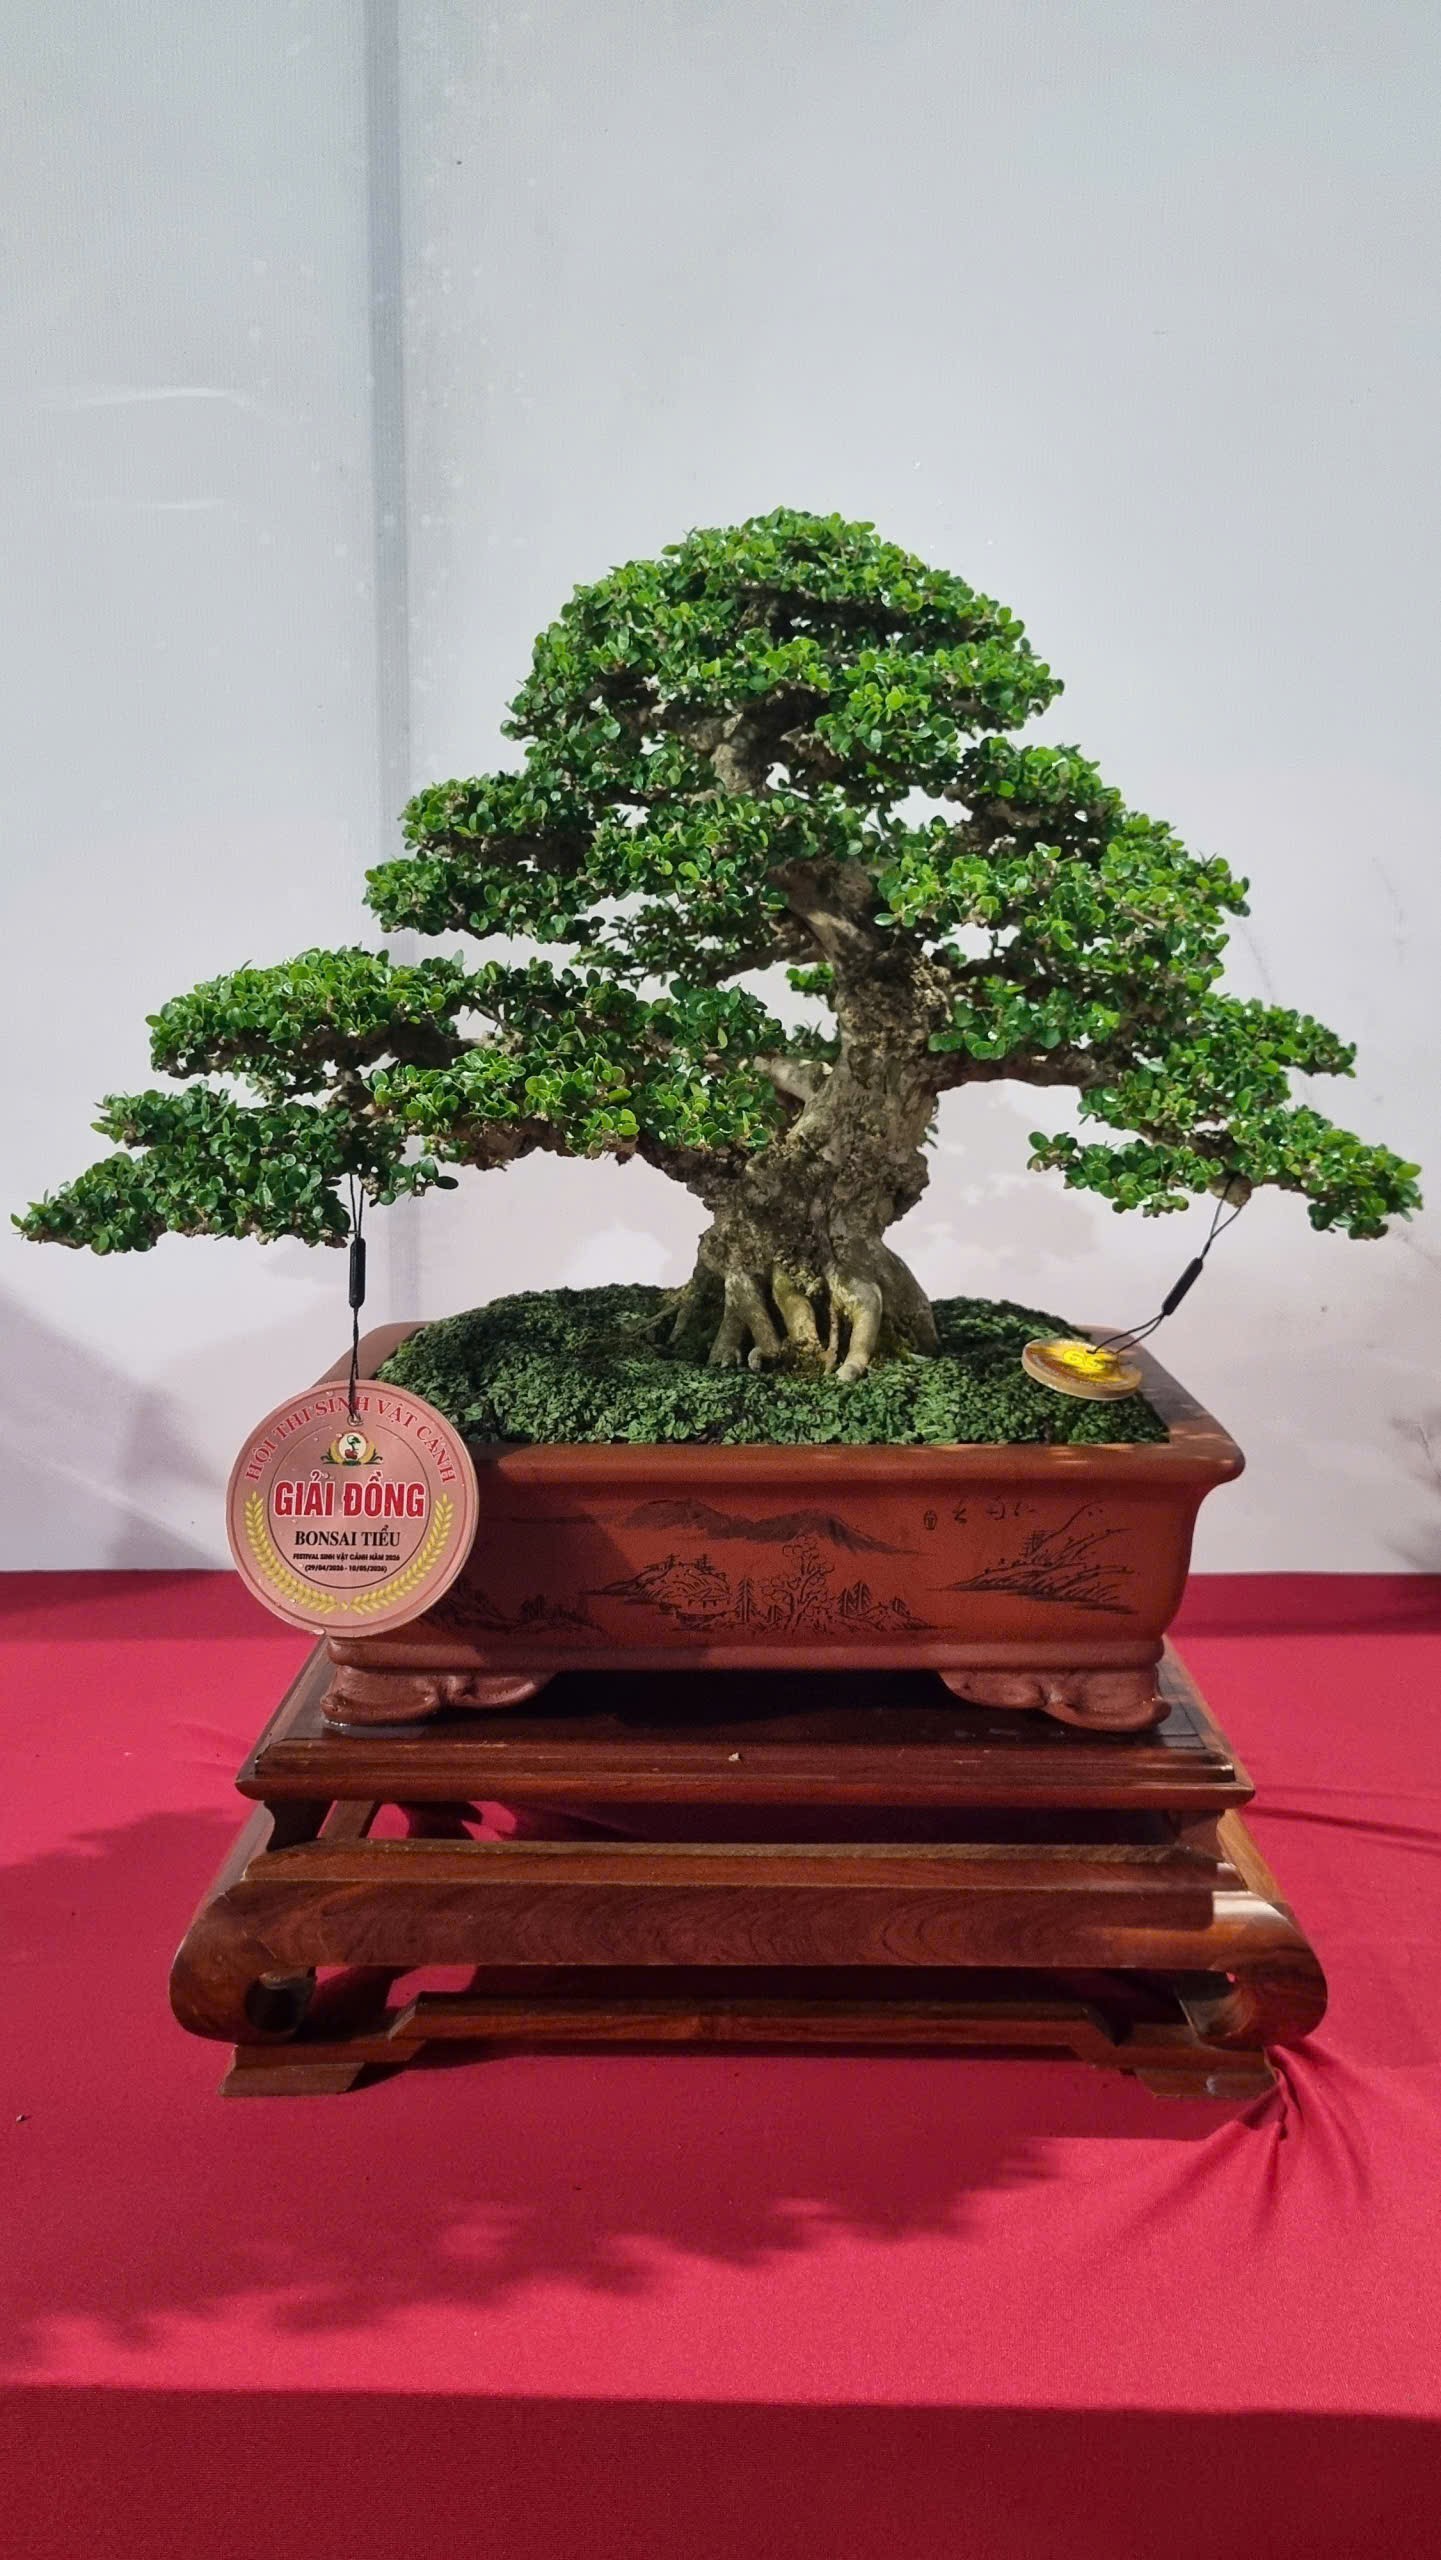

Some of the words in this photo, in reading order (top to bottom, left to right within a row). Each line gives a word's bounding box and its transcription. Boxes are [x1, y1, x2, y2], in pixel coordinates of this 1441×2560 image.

[246, 1437, 278, 1482] HỘI
[272, 1409, 311, 1441] THI
[316, 1395, 370, 1418] SINH
[377, 1398, 418, 1430] VẬT
[417, 1424, 457, 1483] CẢNH
[273, 1468, 335, 1519] GIẢI
[342, 1470, 426, 1519] ĐỒNG
[294, 1530, 357, 1547] BONSAI
[360, 1524, 401, 1548] TIỂU
[292, 1552, 319, 1561] FESTIVAL
[319, 1553, 336, 1561] SINH
[336, 1551, 348, 1563] VẬT
[348, 1551, 369, 1562] CẢNH
[368, 1551, 385, 1562] NĂM
[384, 1553, 401, 1562] 2026
[304, 1563, 344, 1573] (29/04/2026
[348, 1564, 388, 1574] 10/05/2026)
